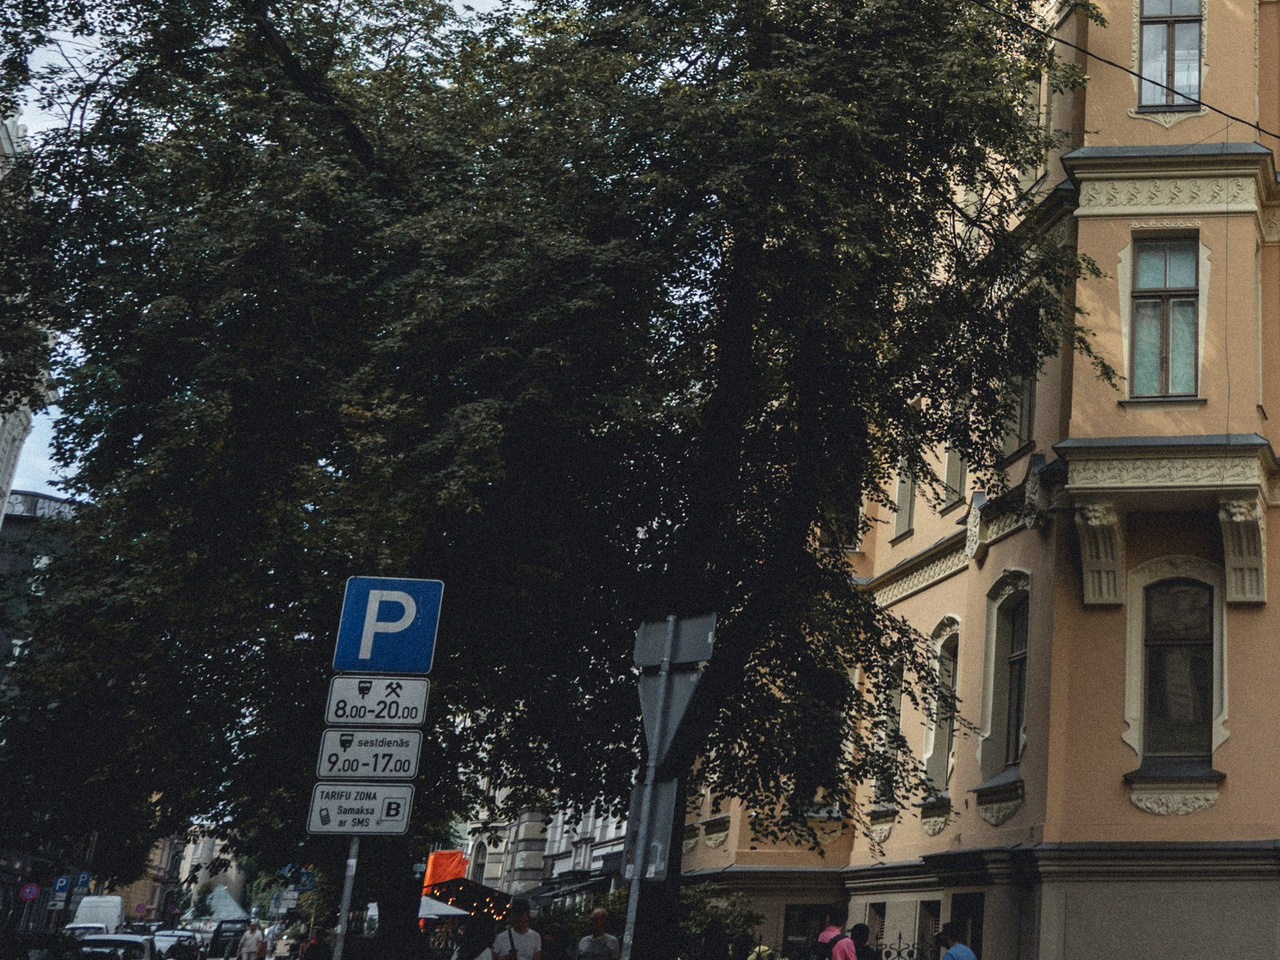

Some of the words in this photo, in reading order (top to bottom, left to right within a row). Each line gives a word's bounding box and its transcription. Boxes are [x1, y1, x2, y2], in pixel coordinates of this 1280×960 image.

[358, 589, 417, 660] P
[334, 699, 418, 720] 8.00-20.00
[319, 790, 352, 801] TARIFU
[353, 791, 378, 801] ZONA
[337, 805, 375, 816] Samaksa
[385, 801, 402, 818] B
[351, 817, 371, 828] SMS
[55, 878, 67, 890] P
